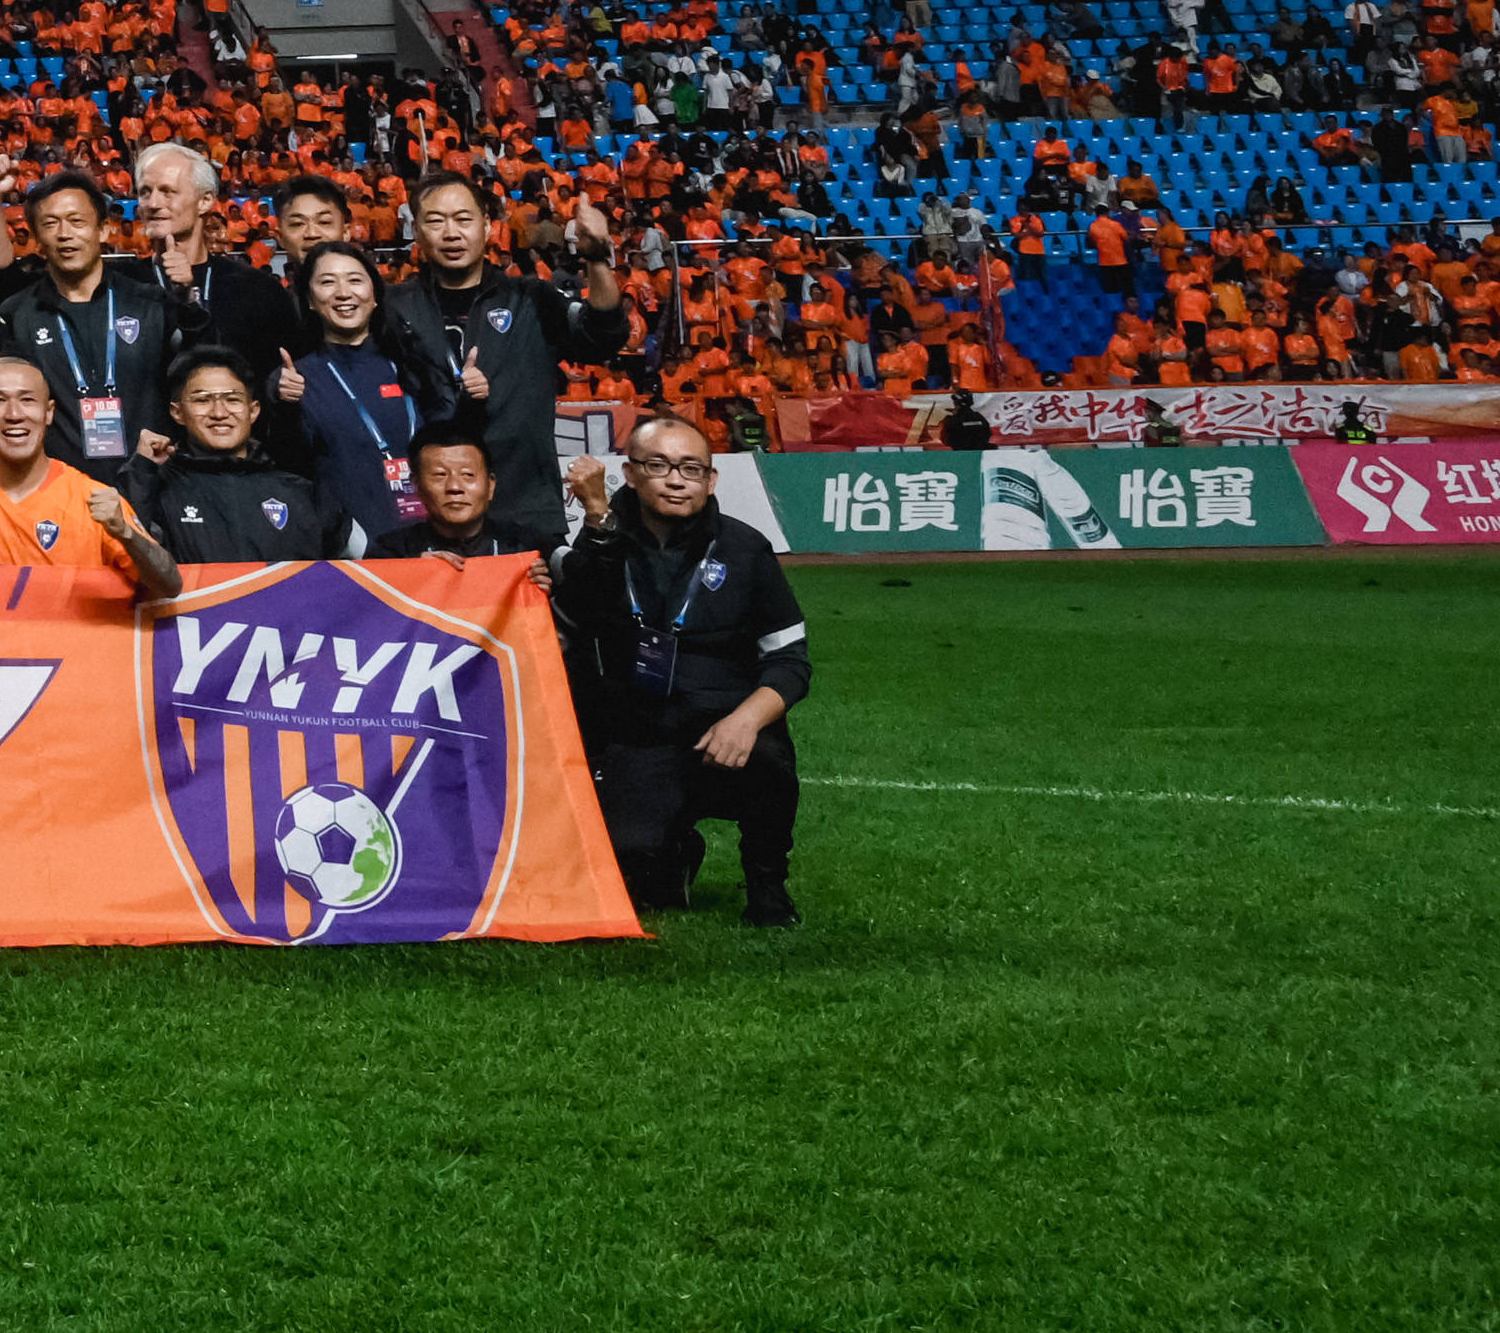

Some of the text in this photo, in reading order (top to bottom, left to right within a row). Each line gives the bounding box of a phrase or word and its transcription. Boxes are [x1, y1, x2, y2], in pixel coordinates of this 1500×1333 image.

[823, 471, 959, 532] 怡寶
[1119, 466, 1257, 528] 怡寶
[172, 616, 484, 722] YNYK
[244, 710, 420, 730] YUNNAN YUKUN FOOTBALL CLUB
